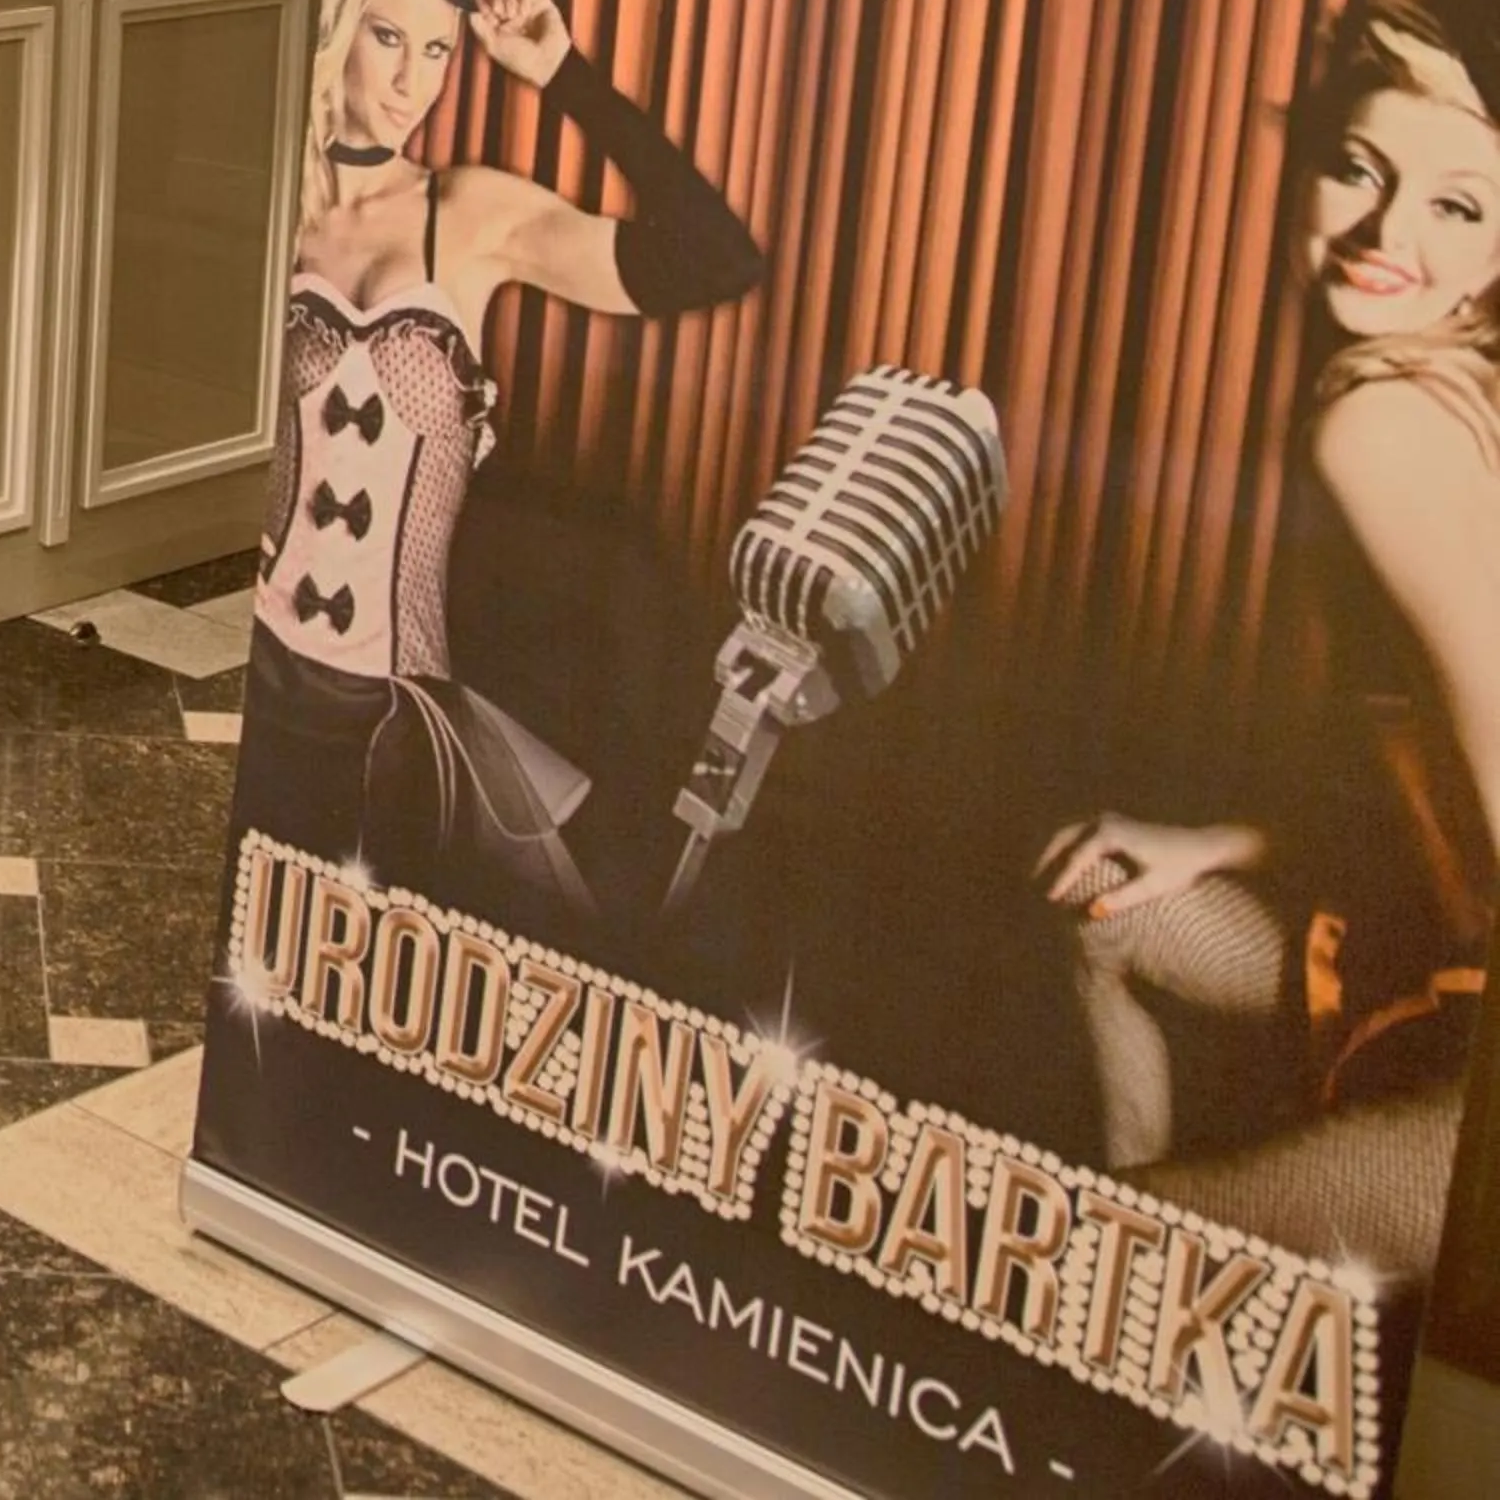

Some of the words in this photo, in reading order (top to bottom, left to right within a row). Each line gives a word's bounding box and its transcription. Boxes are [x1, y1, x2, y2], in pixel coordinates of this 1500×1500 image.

[236, 845, 786, 1210] URODZINY
[790, 1075, 1360, 1476] BARTKA
[394, 1128, 589, 1268] HOTEL
[616, 1234, 1015, 1475] KAMIENICA
